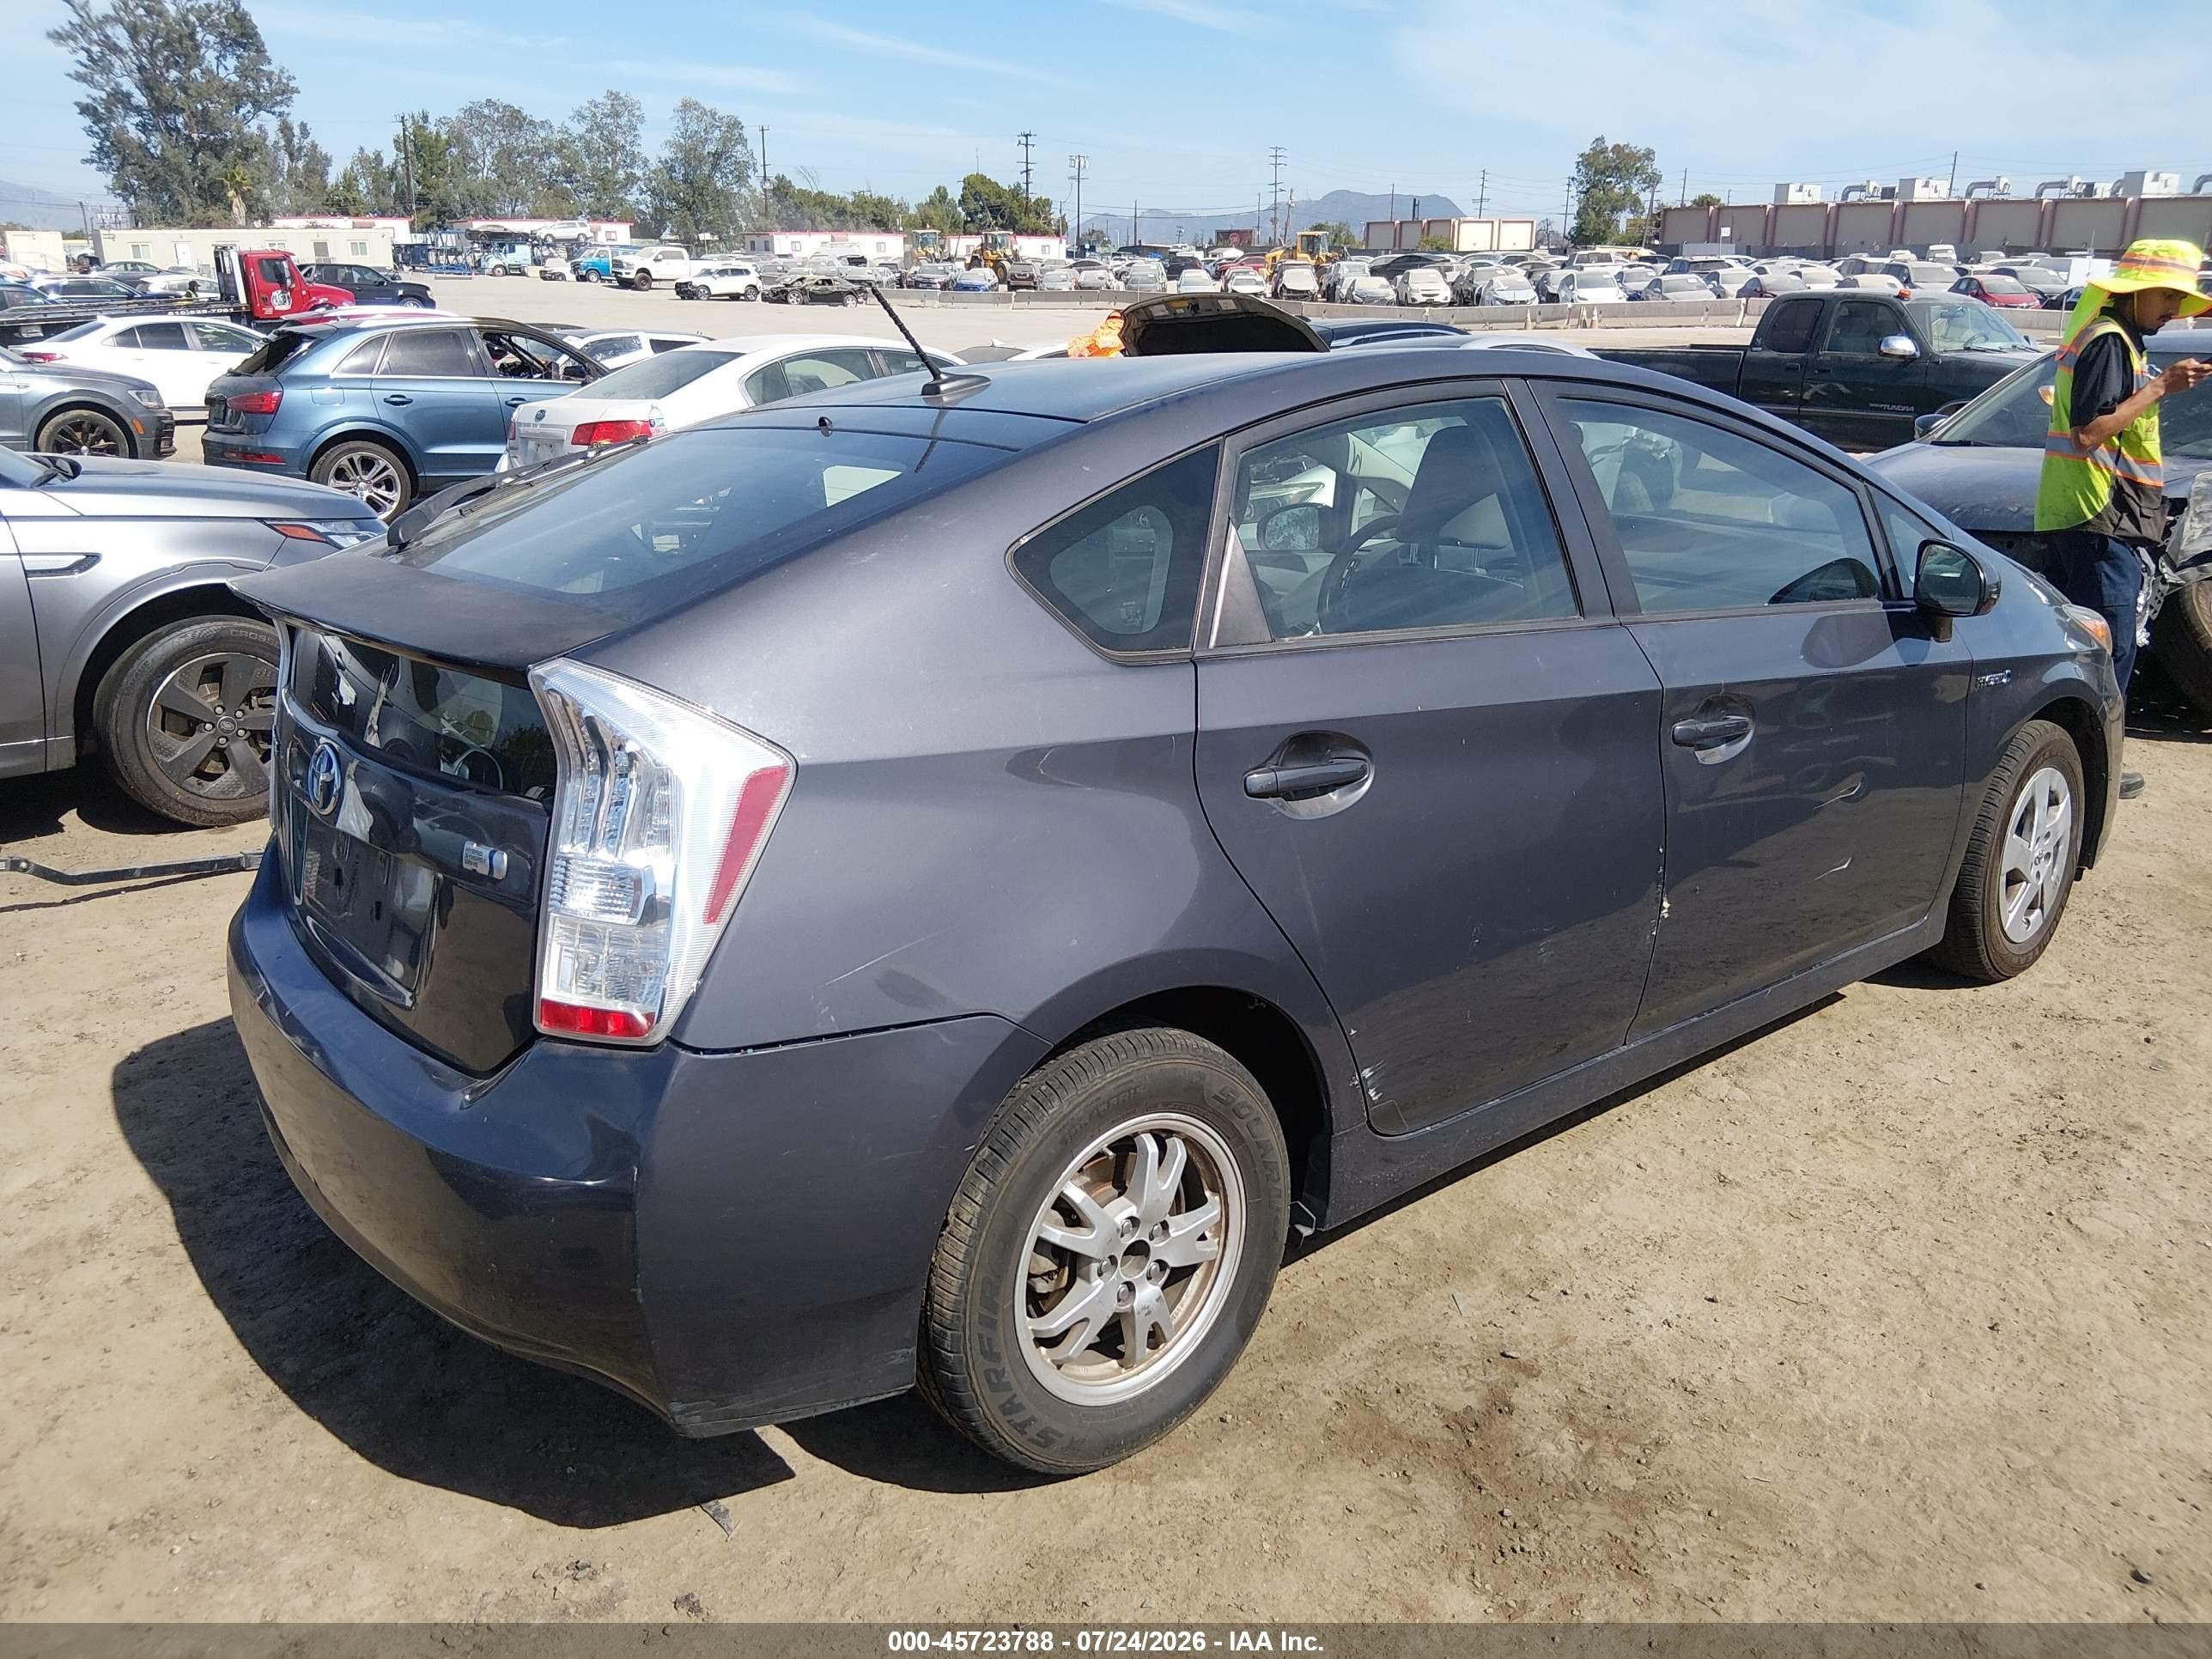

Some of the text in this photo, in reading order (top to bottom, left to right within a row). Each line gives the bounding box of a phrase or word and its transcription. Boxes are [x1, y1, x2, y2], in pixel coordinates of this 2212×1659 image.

[1881, 404, 1915, 412] TUNDRA
[229, 629, 277, 646] CROSS
[465, 847, 483, 857] HYBRID
